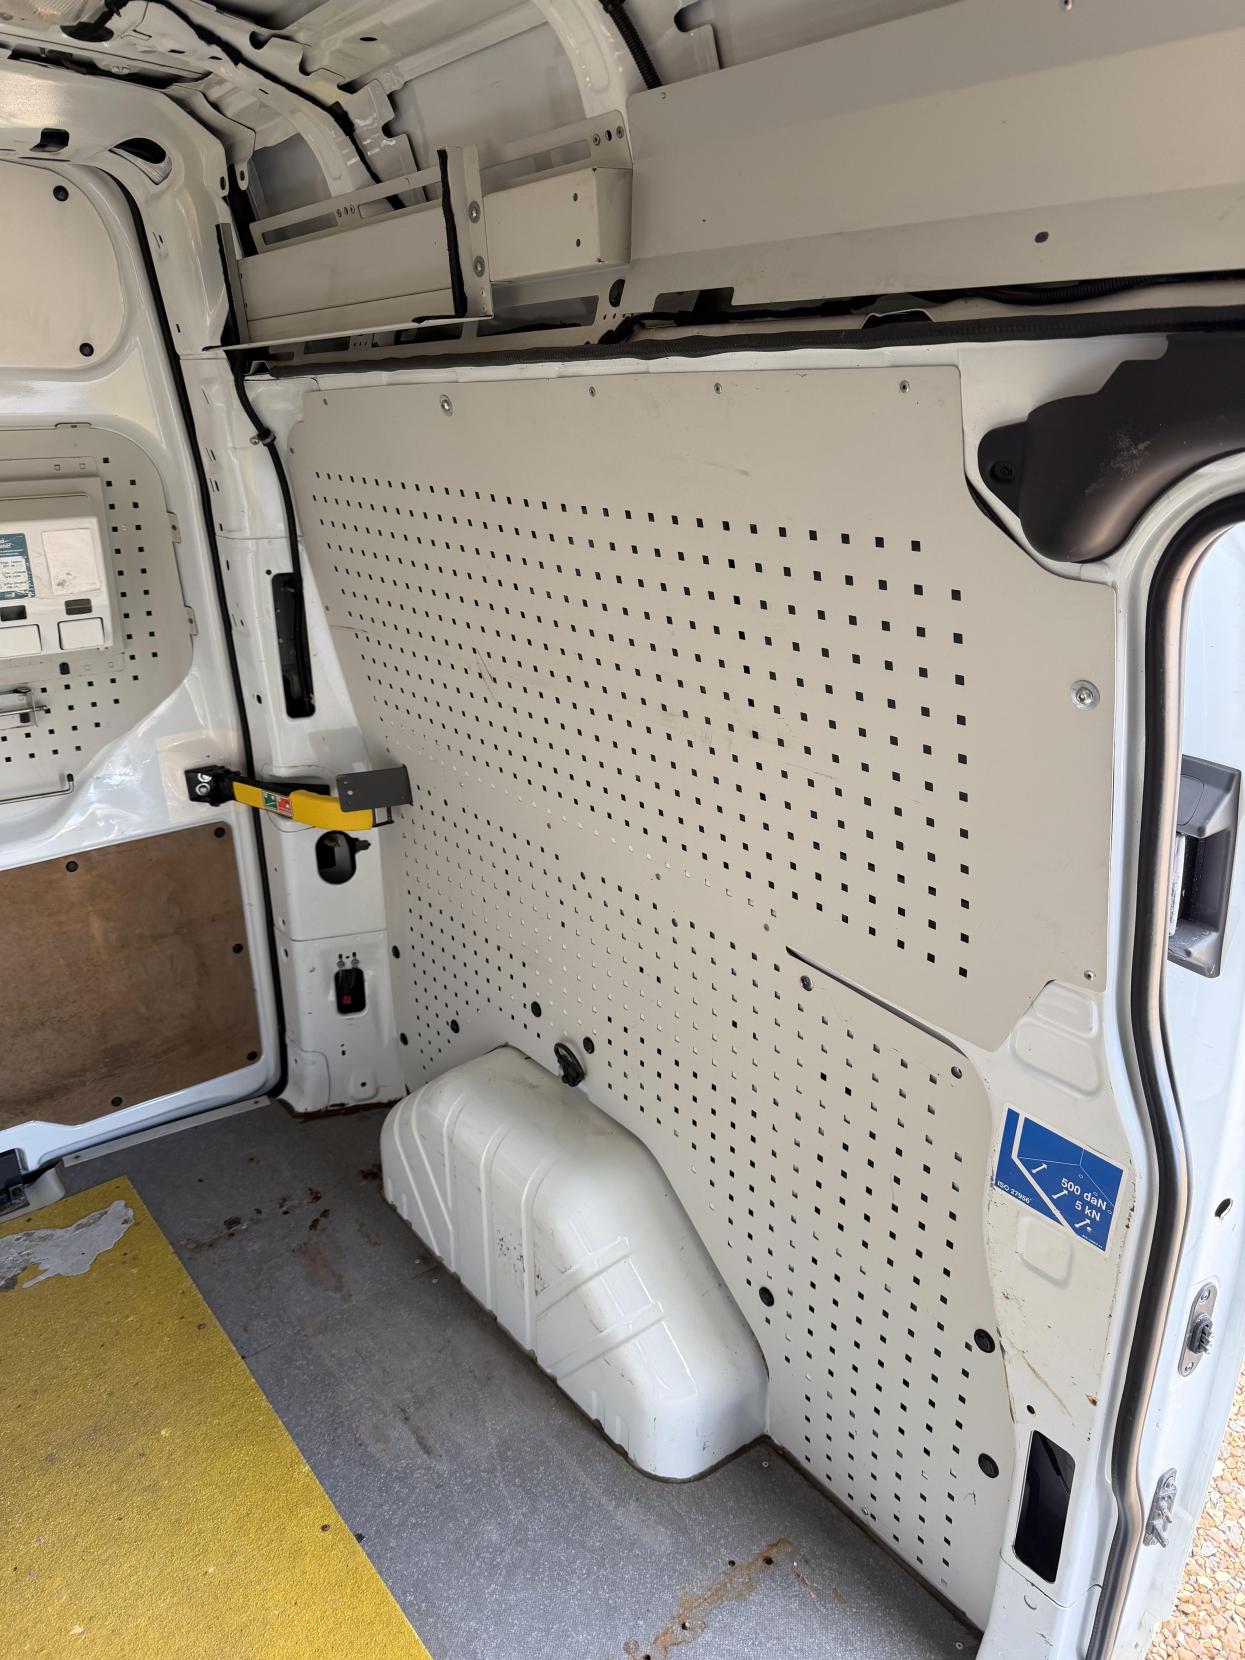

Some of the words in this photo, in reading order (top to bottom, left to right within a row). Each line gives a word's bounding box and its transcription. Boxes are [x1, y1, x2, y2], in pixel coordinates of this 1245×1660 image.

[997, 1180, 1010, 1192] ISO
[1010, 1188, 1031, 1204] 27956
[1061, 1178, 1081, 1196] 500
[1083, 1192, 1107, 1211] daN
[1074, 1200, 1082, 1210] 5
[1084, 1205, 1101, 1222] kN
